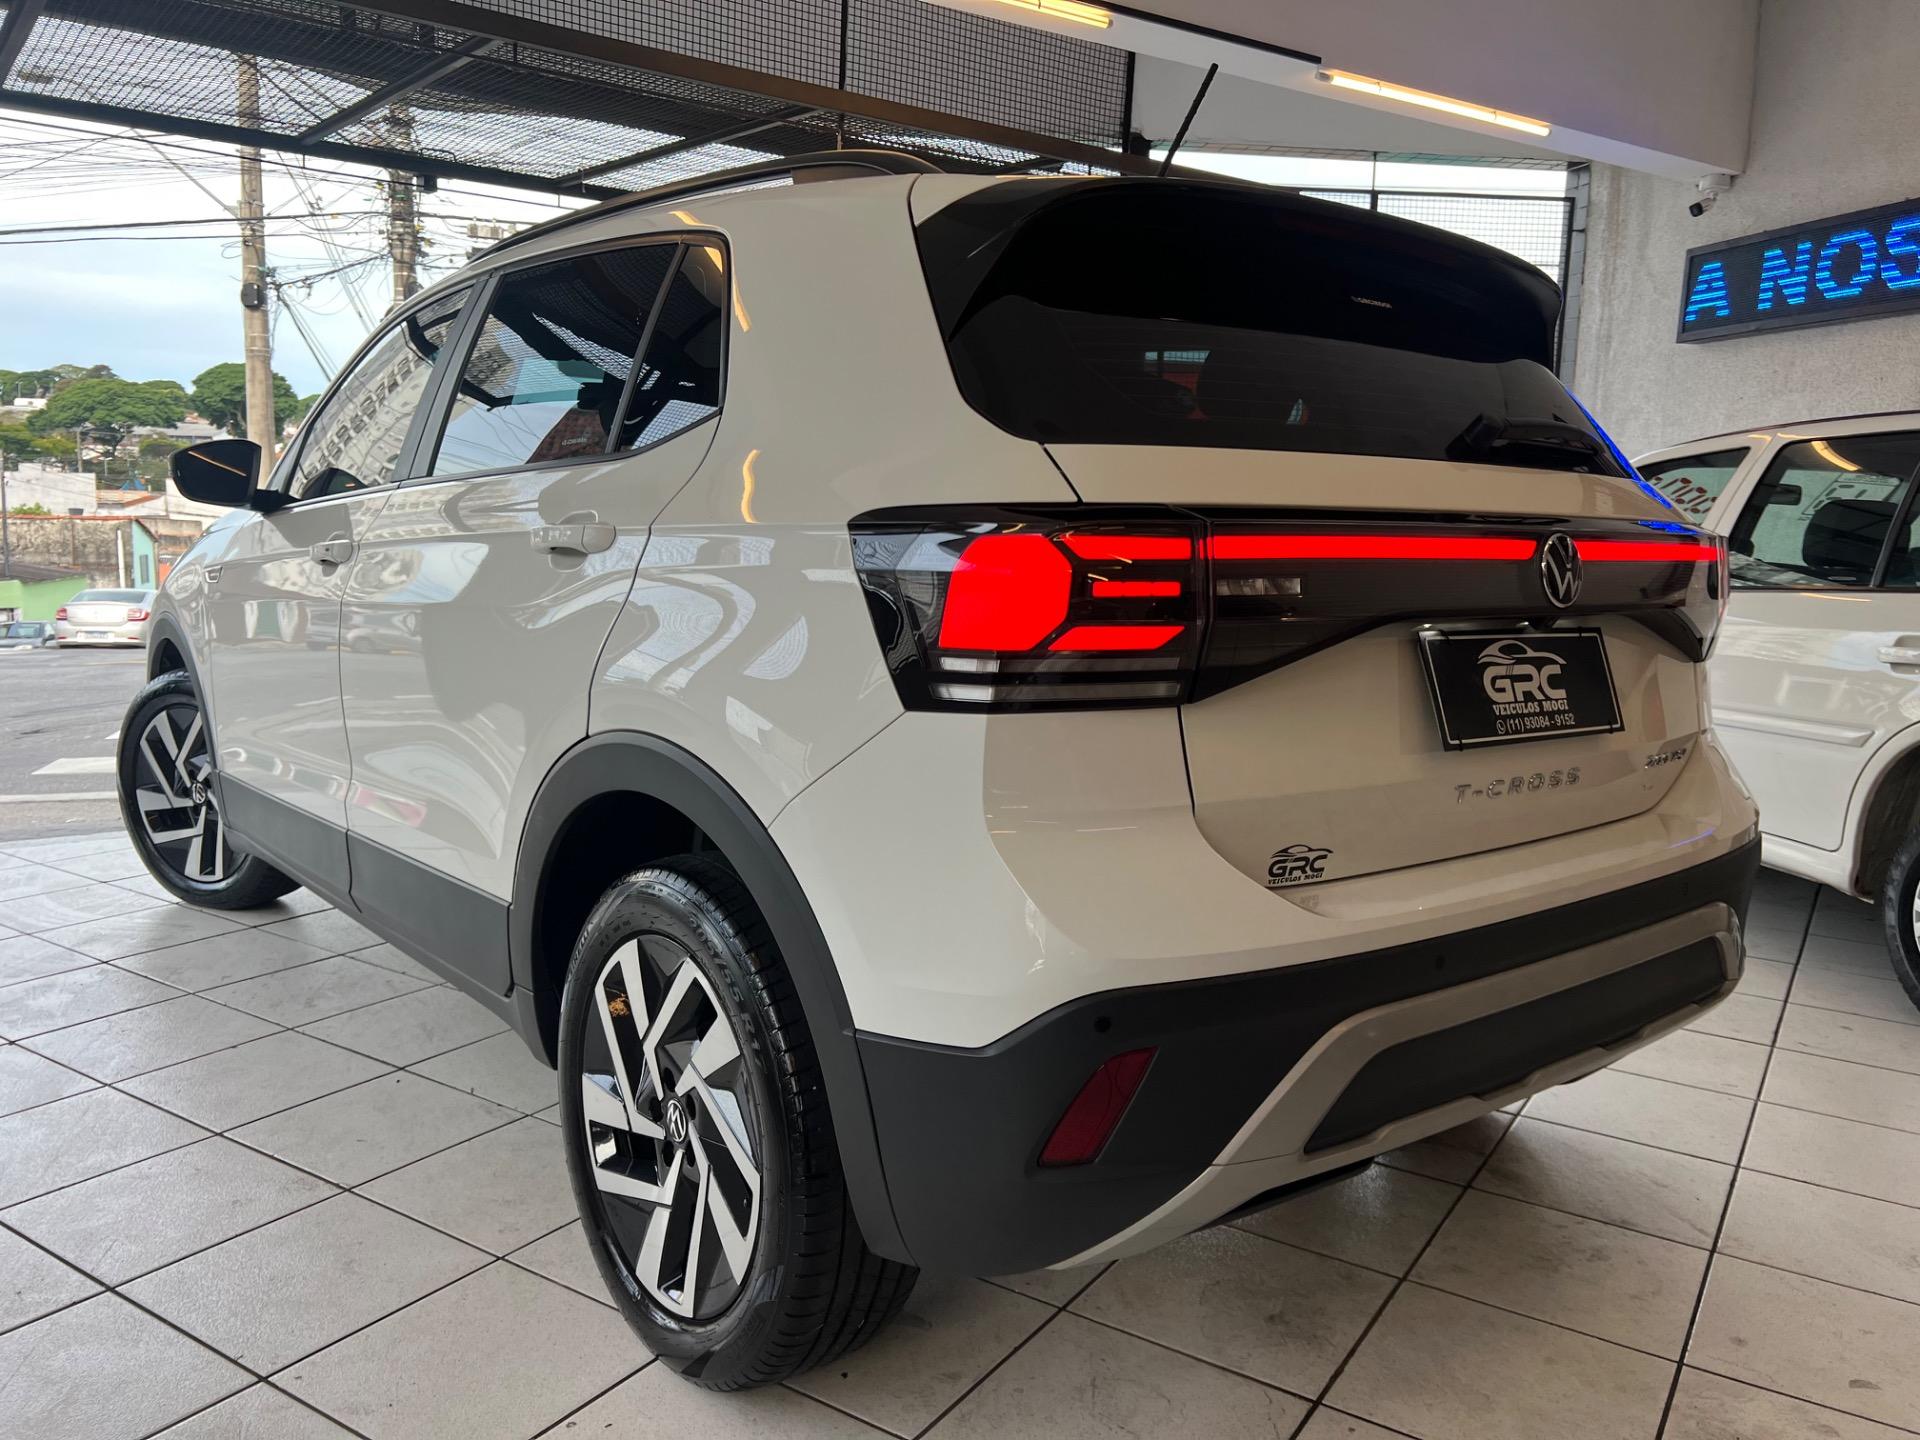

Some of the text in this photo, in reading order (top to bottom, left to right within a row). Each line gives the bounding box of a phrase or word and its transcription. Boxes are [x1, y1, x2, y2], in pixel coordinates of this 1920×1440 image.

[1685, 262, 1730, 321] A
[1483, 664, 1567, 703] GRC
[1493, 699, 1569, 715] VEICULOS MOGI
[1454, 767, 1581, 804] T-CROSS
[1268, 854, 1328, 878] GRC
